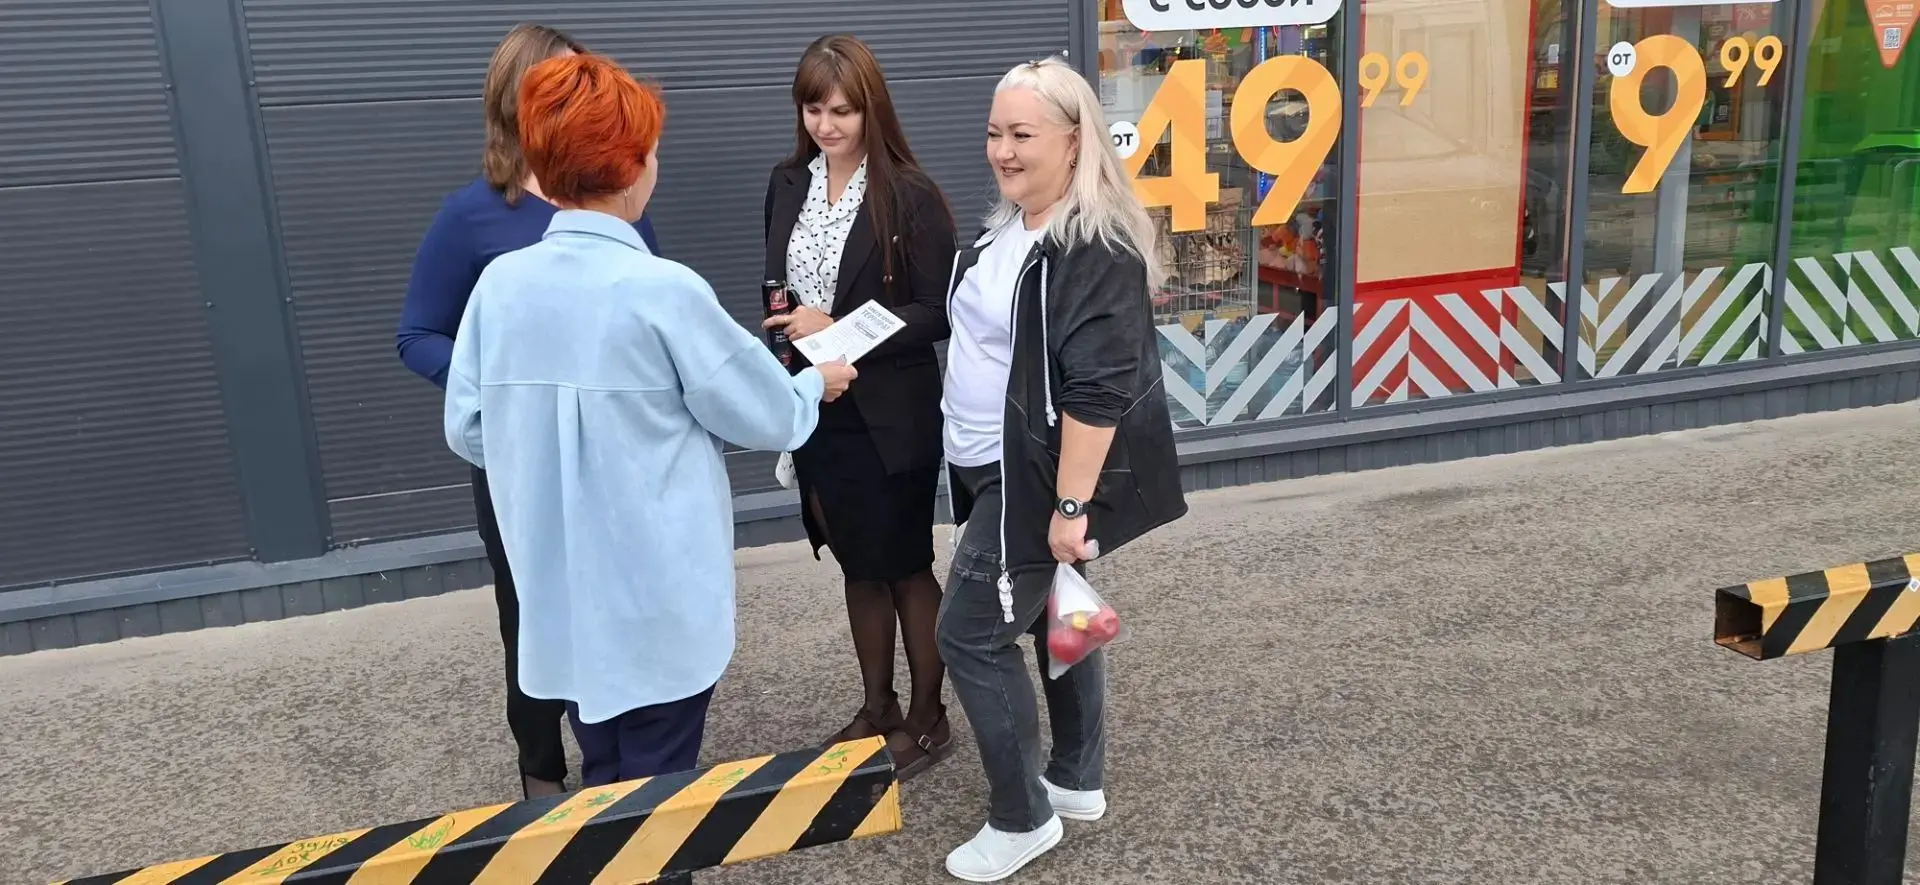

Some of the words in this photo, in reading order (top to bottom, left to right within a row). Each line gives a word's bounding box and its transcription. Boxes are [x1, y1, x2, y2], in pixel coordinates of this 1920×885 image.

[1127, 55, 1342, 232] 49
[1358, 51, 1429, 108] 99
[1610, 34, 1707, 194] 9
[1720, 35, 1783, 88] 99
